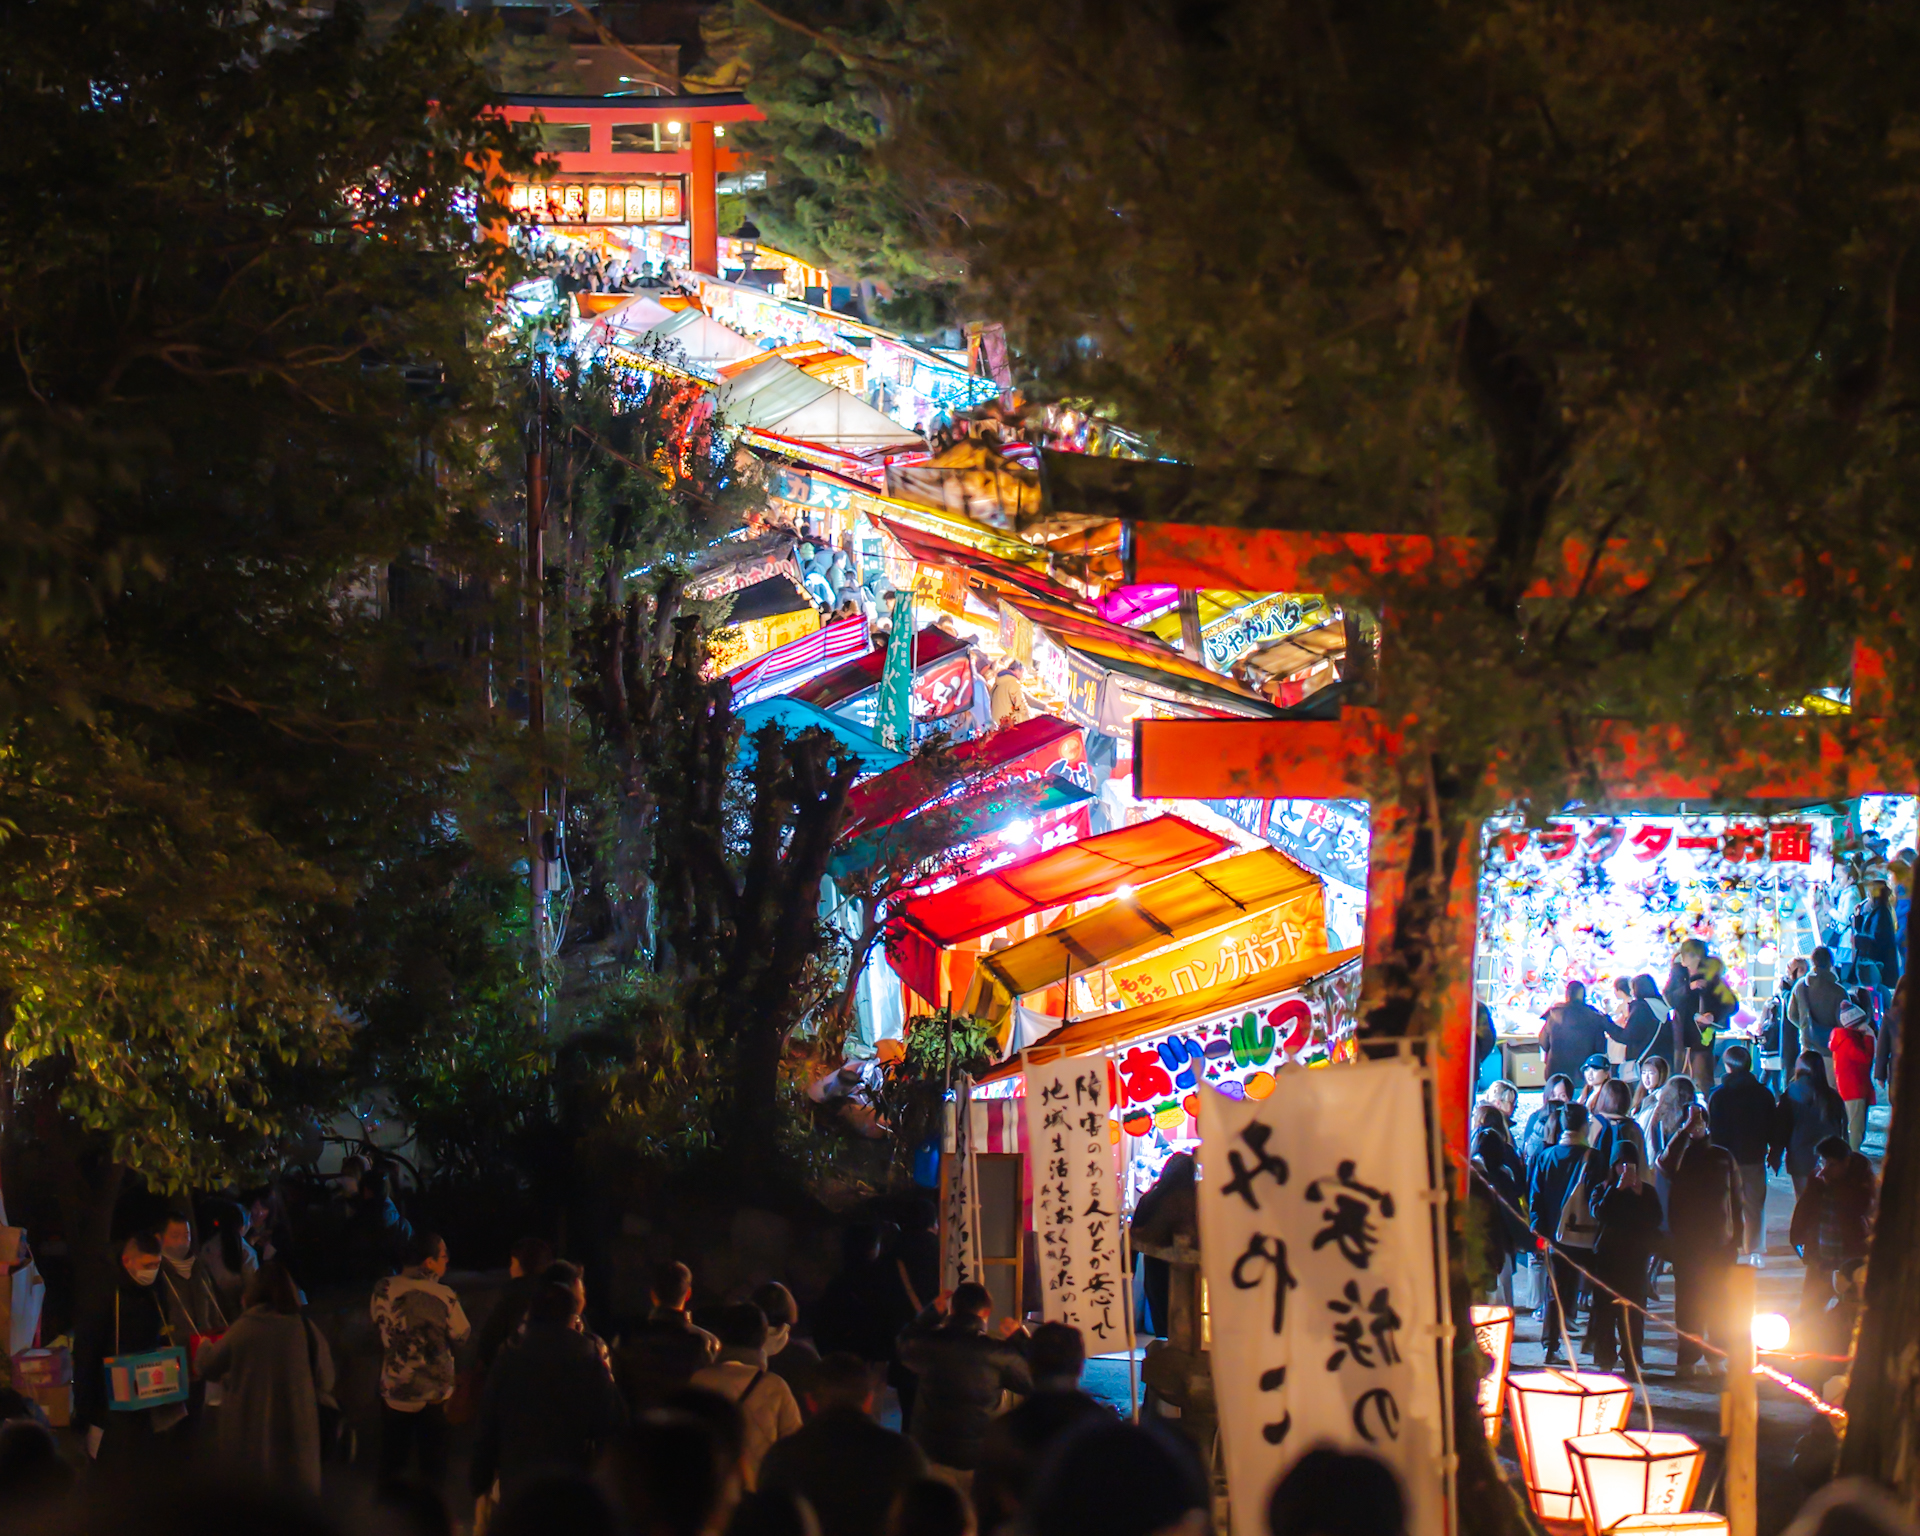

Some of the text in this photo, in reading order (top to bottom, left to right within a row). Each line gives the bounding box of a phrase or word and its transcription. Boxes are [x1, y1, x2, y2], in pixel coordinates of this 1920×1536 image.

[1207, 600, 1321, 663] じゃがバター
[1119, 973, 1152, 993] もち
[1170, 921, 1301, 995] ロングポテト
[1041, 1077, 1081, 1324] 地域生活をおくるために
[1075, 1070, 1116, 1340] 障害のある人びとが安心して
